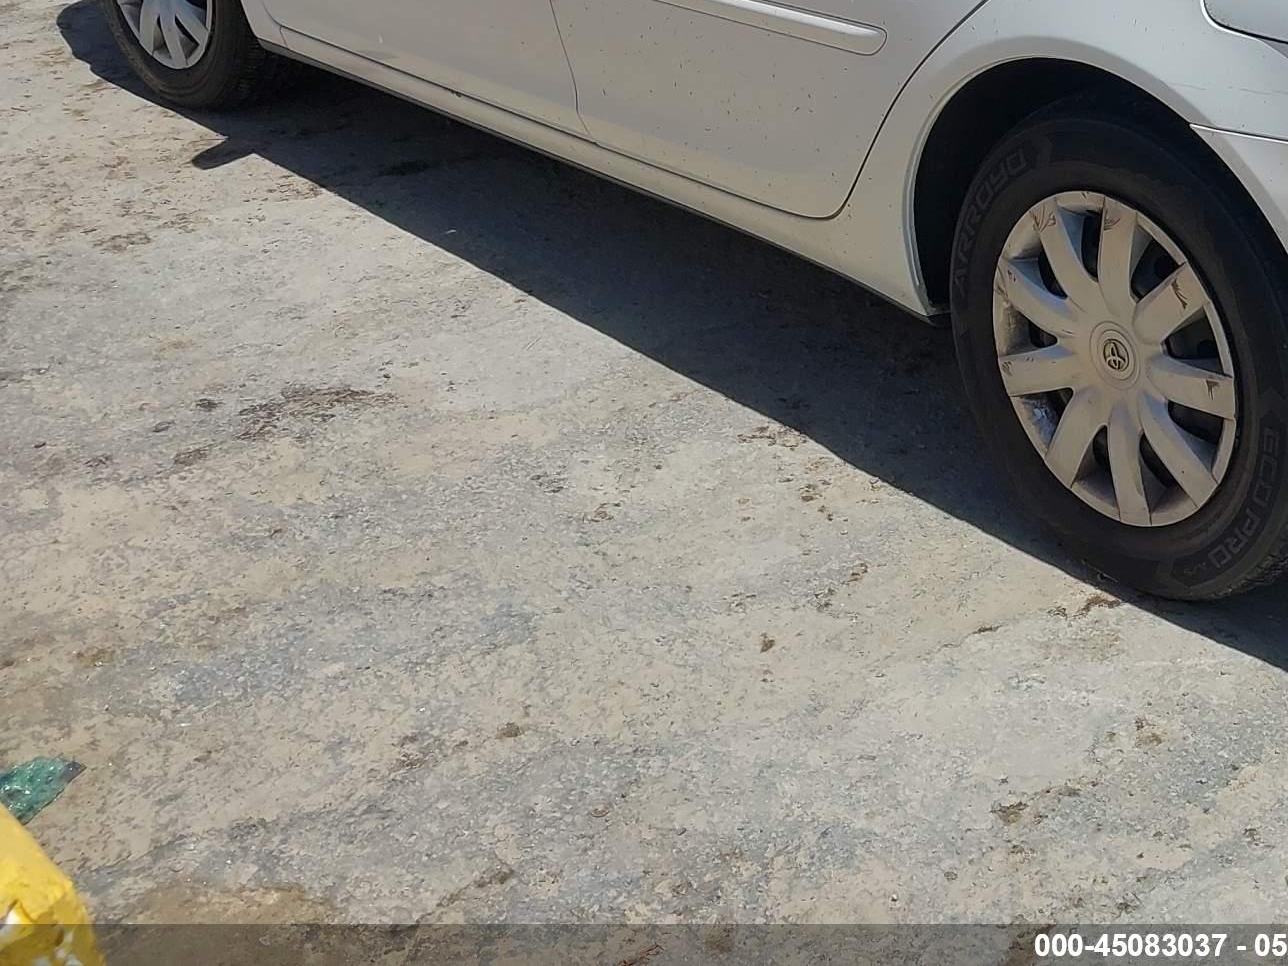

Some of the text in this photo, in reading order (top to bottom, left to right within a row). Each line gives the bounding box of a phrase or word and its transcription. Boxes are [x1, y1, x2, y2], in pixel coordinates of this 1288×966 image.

[953, 148, 1029, 298] ARROYO
[1207, 427, 1281, 568] ECO PRO
